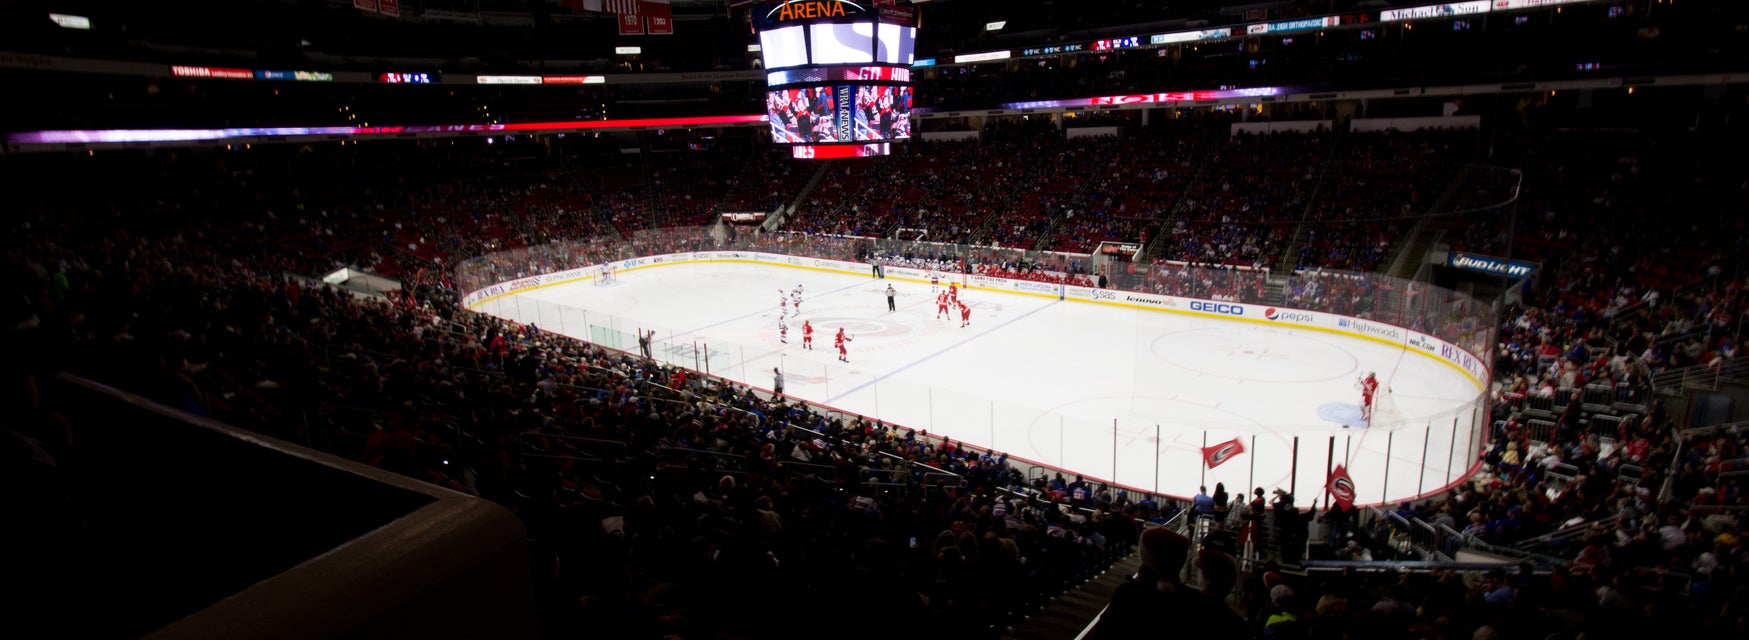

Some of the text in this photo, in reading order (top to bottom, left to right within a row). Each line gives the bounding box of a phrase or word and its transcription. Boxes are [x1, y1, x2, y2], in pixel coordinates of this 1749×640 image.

[779, 1, 846, 21] ARENA
[1391, 4, 1480, 19] Michael Son
[1268, 22, 1288, 32] RAEIGH
[172, 65, 210, 77] TOSHIBA
[1091, 90, 1217, 104] NOISE
[840, 86, 850, 140] WRAL NEWS
[1459, 257, 1531, 275] BUD LIGHT
[1126, 295, 1162, 305] lenovo
[1189, 301, 1244, 315] GEICO
[1281, 311, 1314, 322] pepsi
[1347, 319, 1400, 339] Highwoods
[1441, 343, 1462, 364] REX
